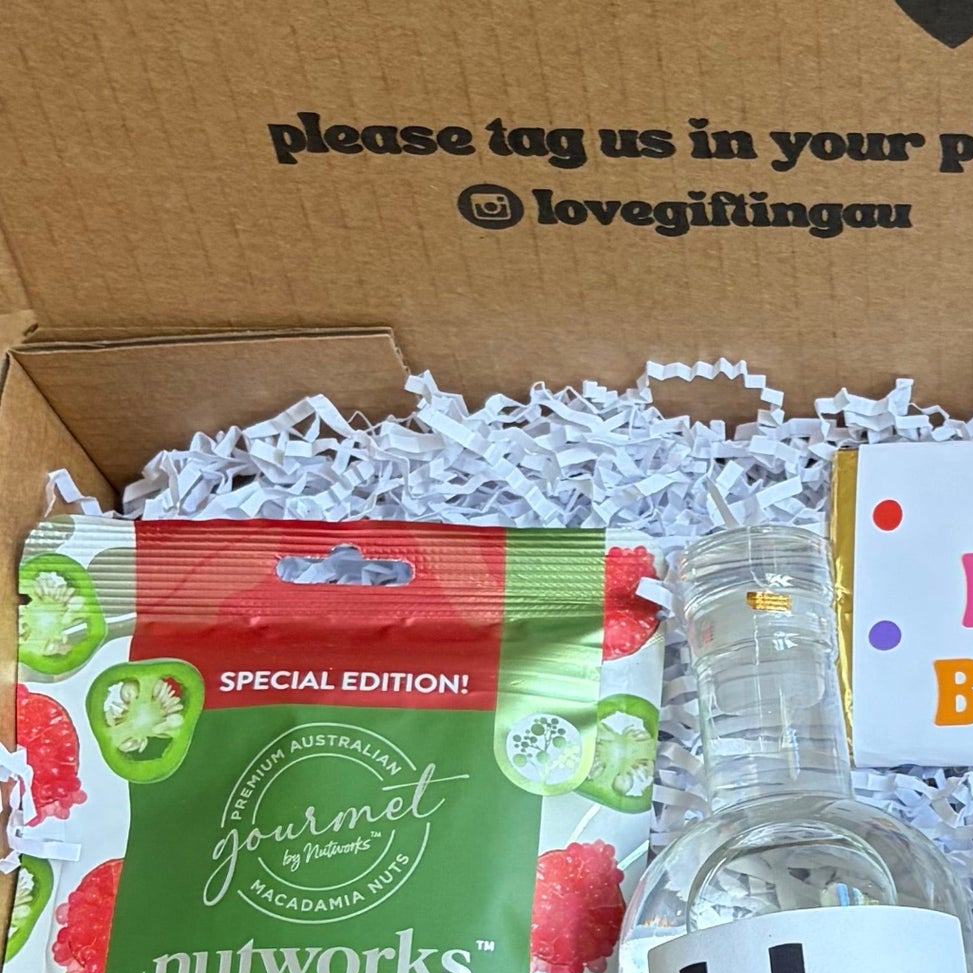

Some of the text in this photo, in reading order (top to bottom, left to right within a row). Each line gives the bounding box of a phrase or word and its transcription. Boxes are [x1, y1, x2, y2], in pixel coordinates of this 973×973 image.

[268, 111, 476, 165] please
[488, 117, 586, 170] tag
[600, 124, 677, 160] us
[688, 117, 758, 161] in
[770, 130, 925, 172] your
[530, 188, 914, 239] lovegiftingau
[219, 670, 469, 694] SPECIAL EDITION!
[230, 734, 402, 821] PREMIUM AUSTRALIAN
[203, 763, 470, 906] gourmet
[282, 849, 301, 873] by
[303, 836, 371, 863] Nutworks
[250, 852, 410, 912] MACADAMIA NUTS
